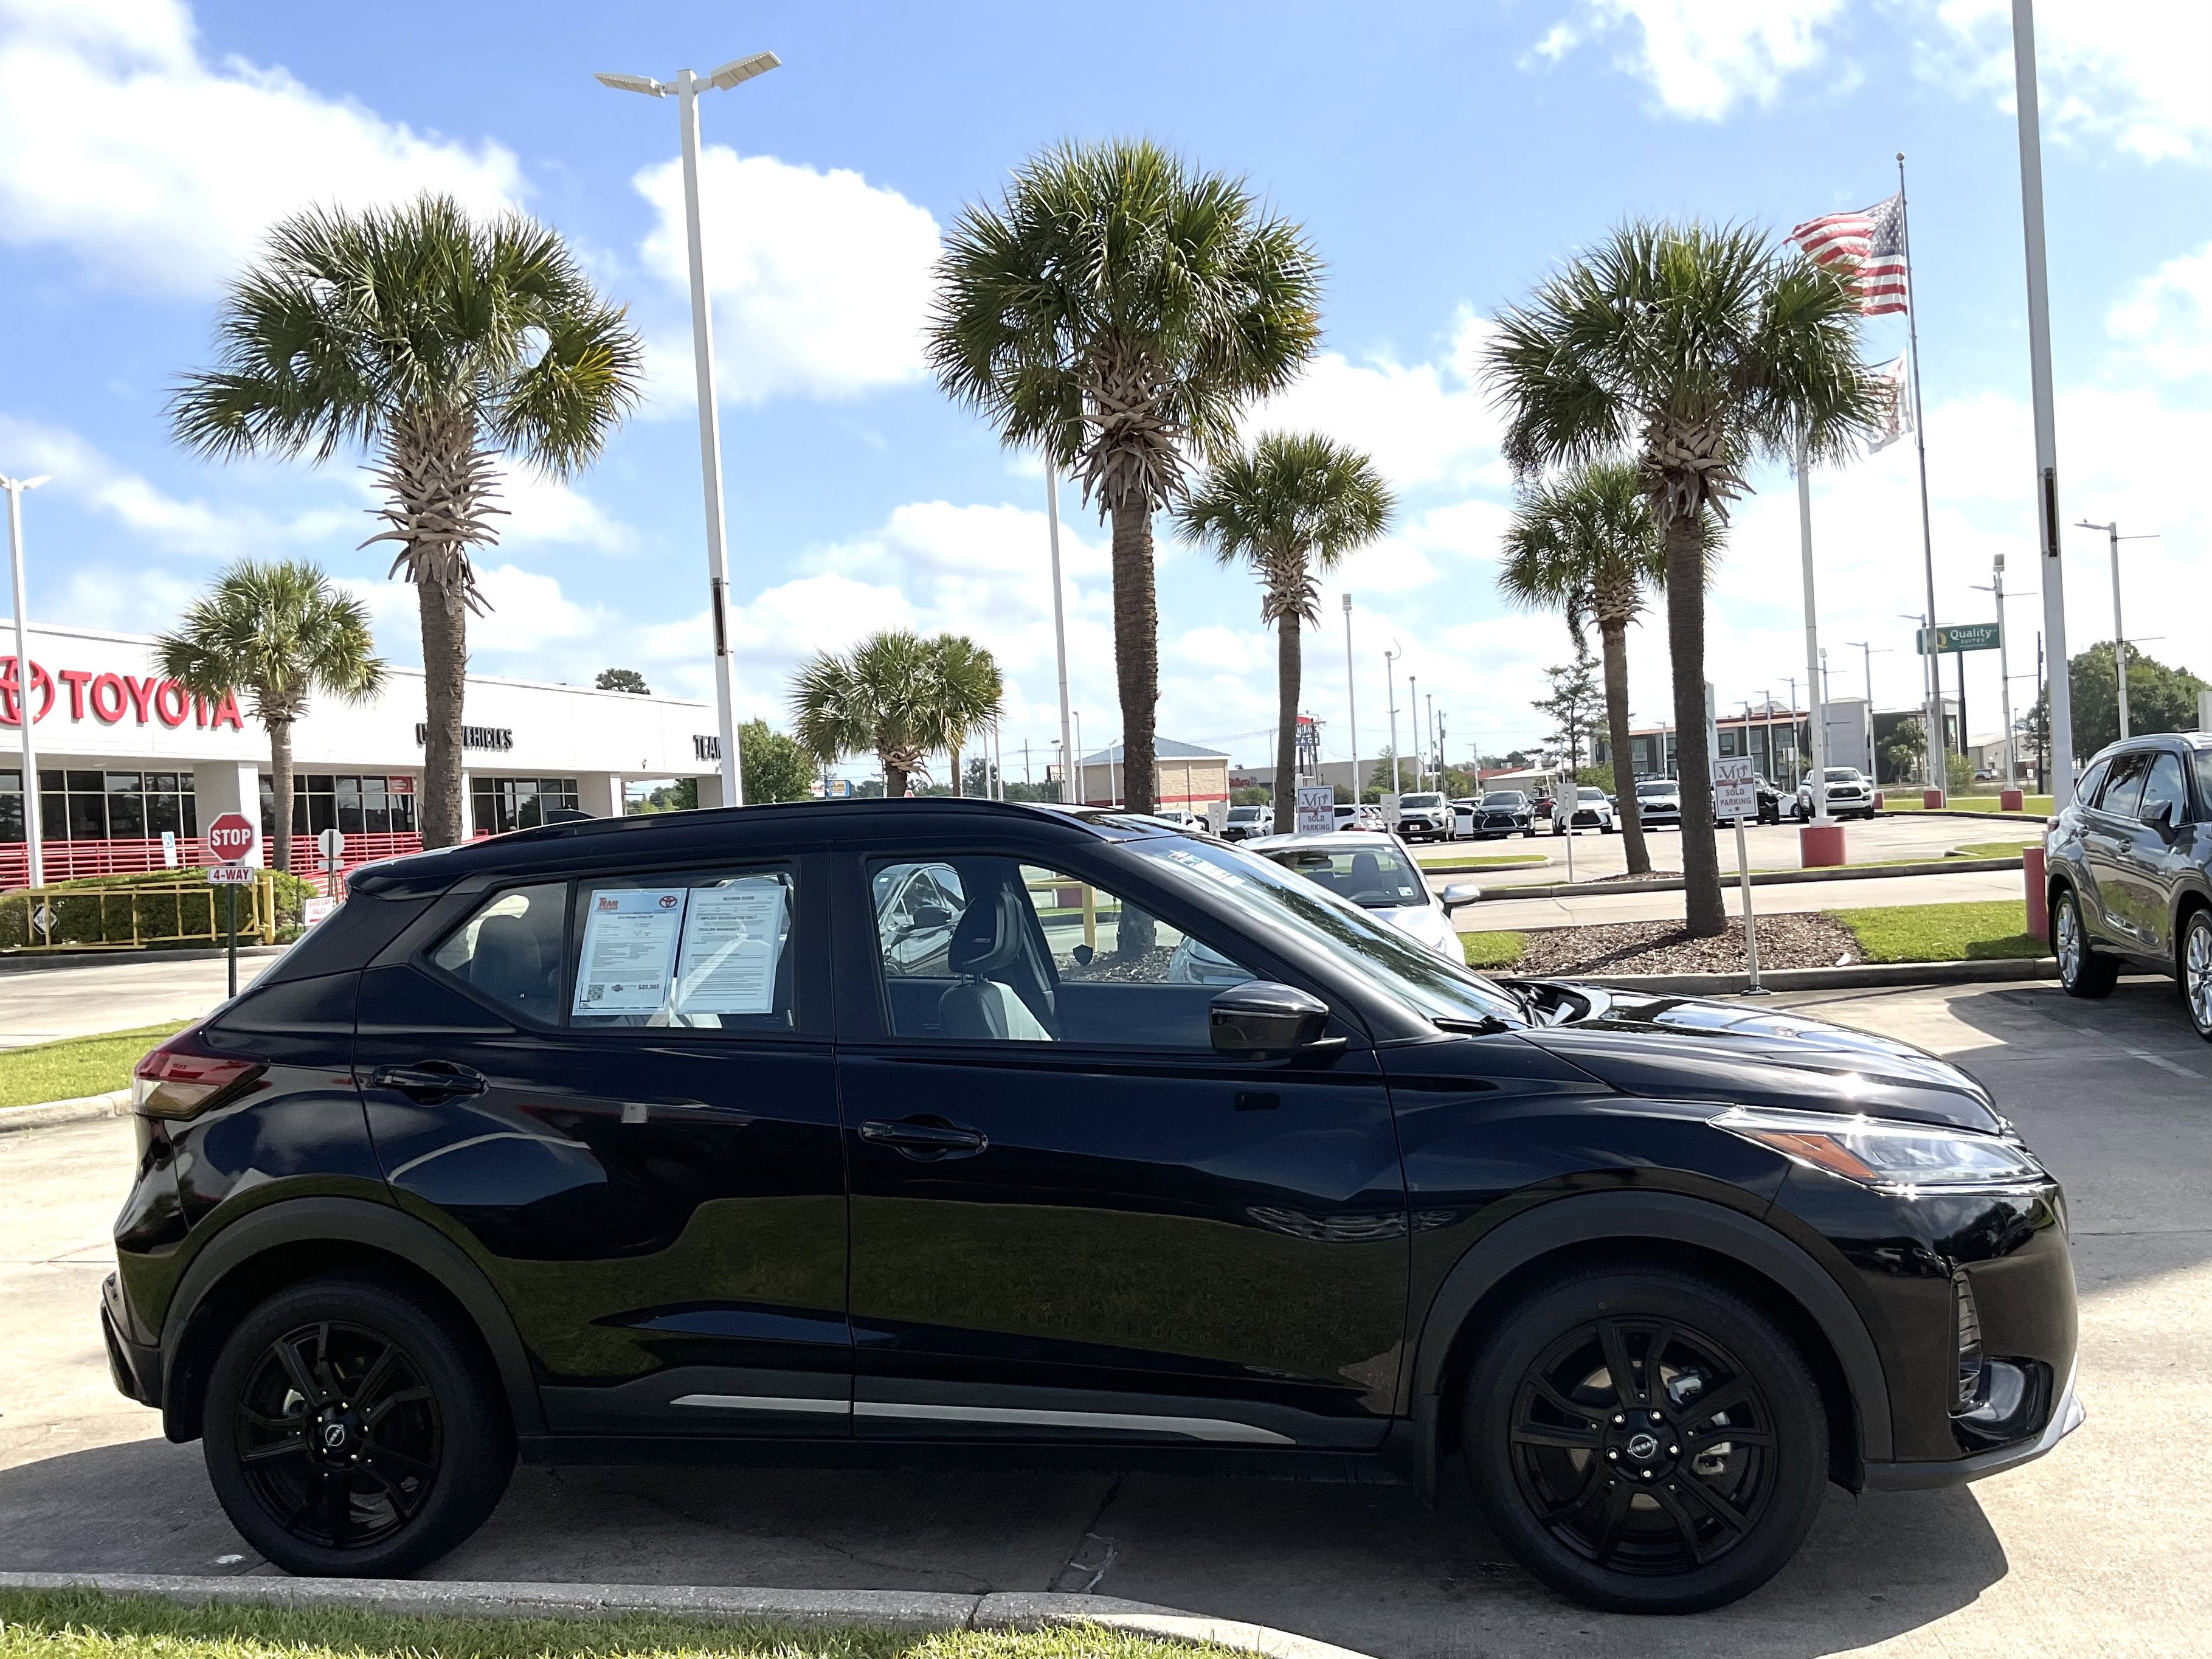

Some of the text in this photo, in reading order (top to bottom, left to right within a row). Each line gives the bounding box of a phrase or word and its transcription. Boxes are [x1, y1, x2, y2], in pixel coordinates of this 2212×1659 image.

[1950, 628, 1993, 640] Quality
[1720, 797, 1751, 806] PARKING
[212, 828, 251, 846] STOP
[213, 870, 249, 880] 4-WAY
